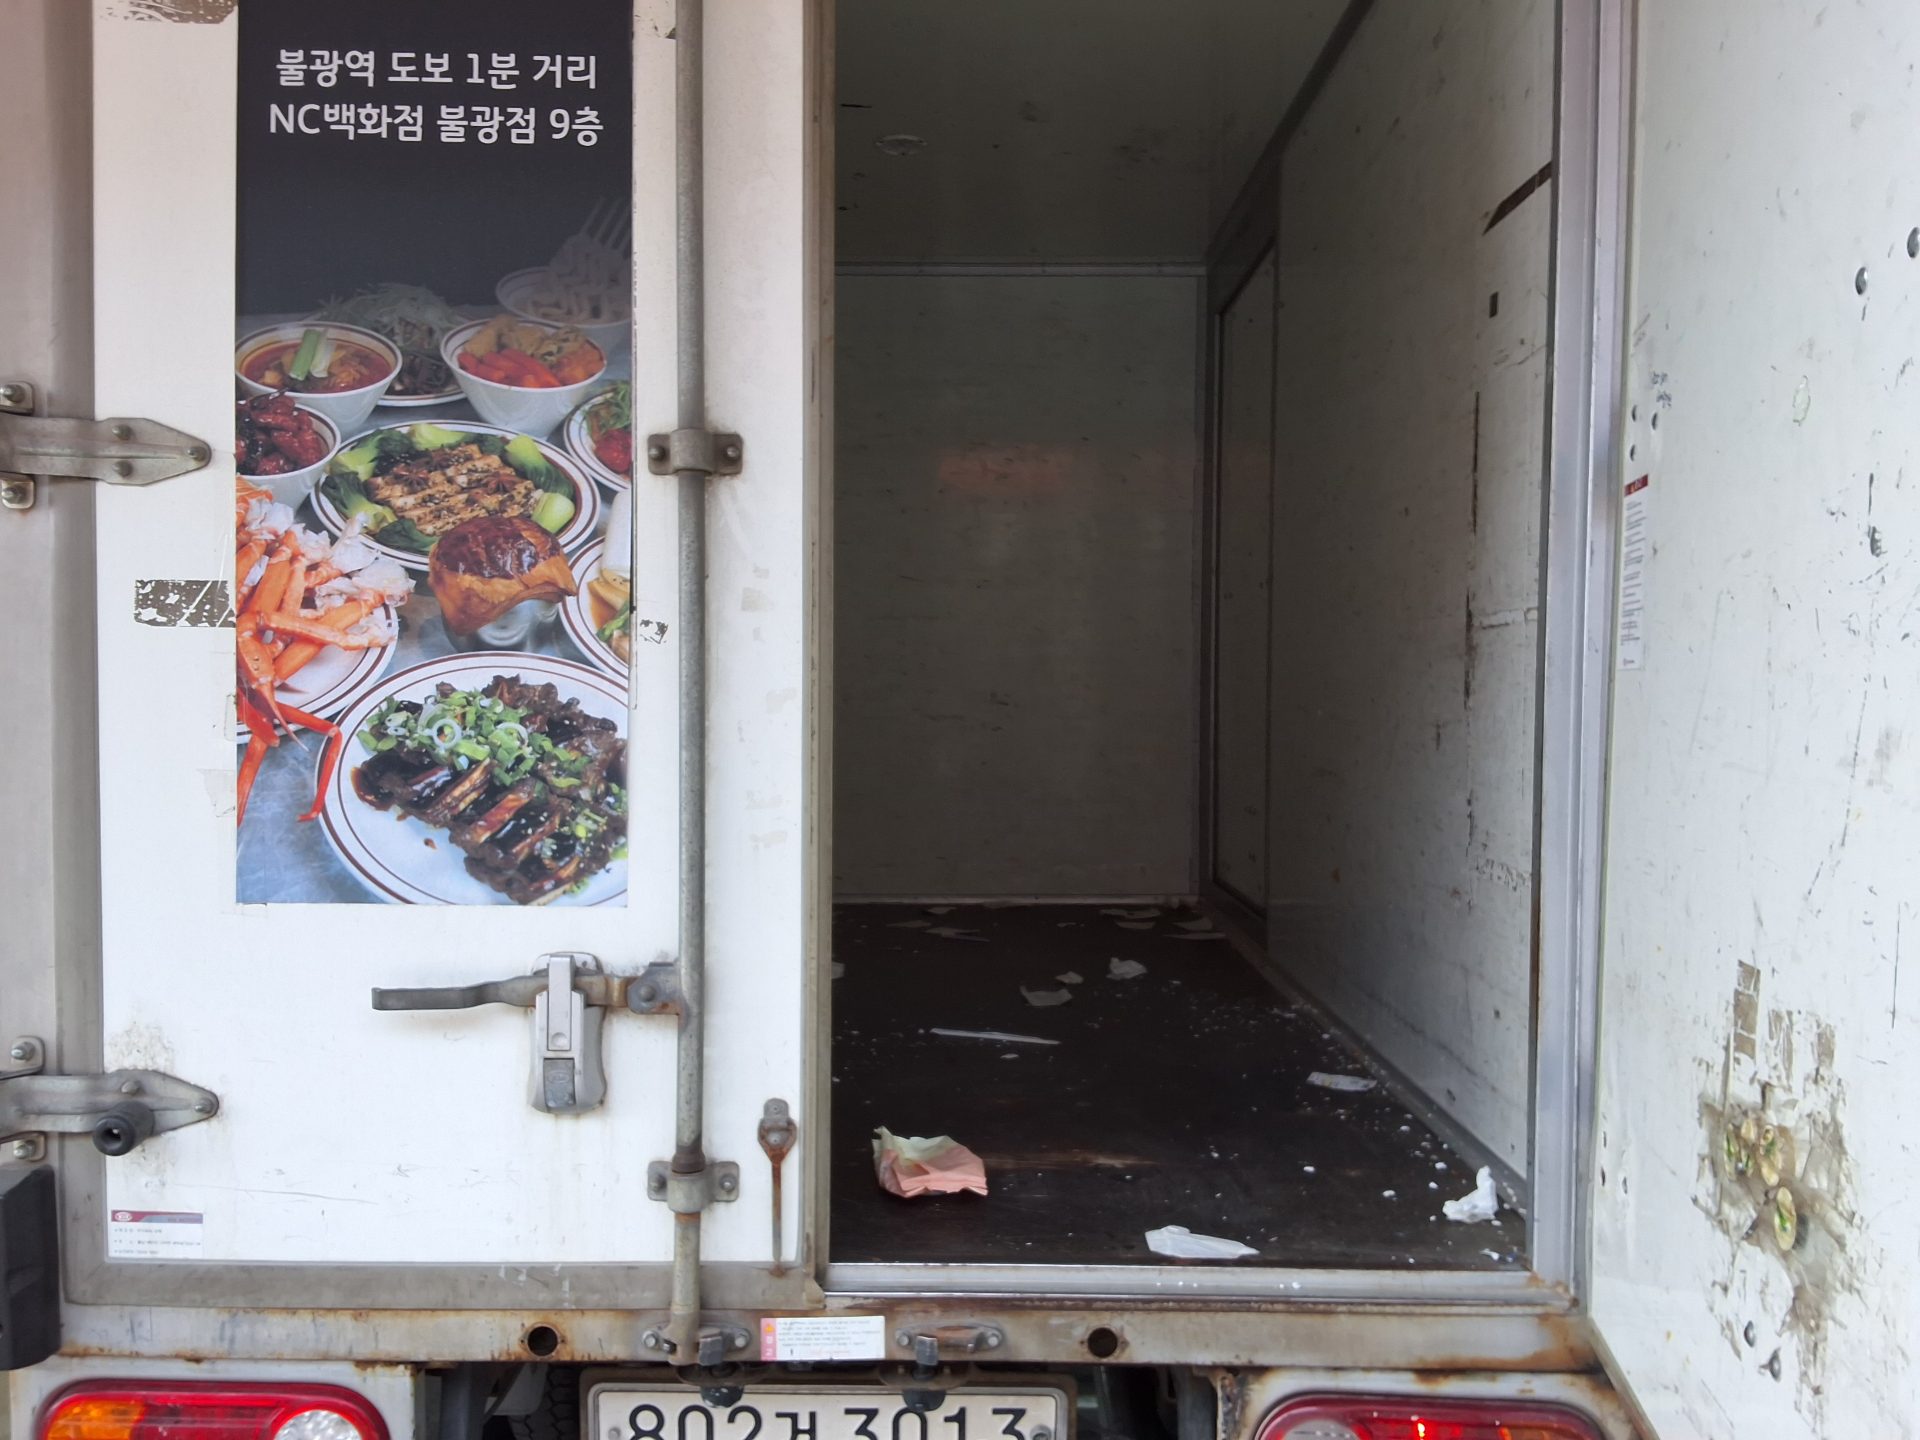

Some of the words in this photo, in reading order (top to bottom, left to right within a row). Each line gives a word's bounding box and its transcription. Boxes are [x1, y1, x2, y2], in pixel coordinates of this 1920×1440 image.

[276, 49, 375, 87] 불광역
[387, 52, 453, 83] 도보
[466, 53, 519, 89] 1분
[532, 55, 596, 89] 거리
[269, 103, 423, 142] NC백화점
[436, 105, 536, 144] 불광점
[549, 106, 604, 147] 9층
